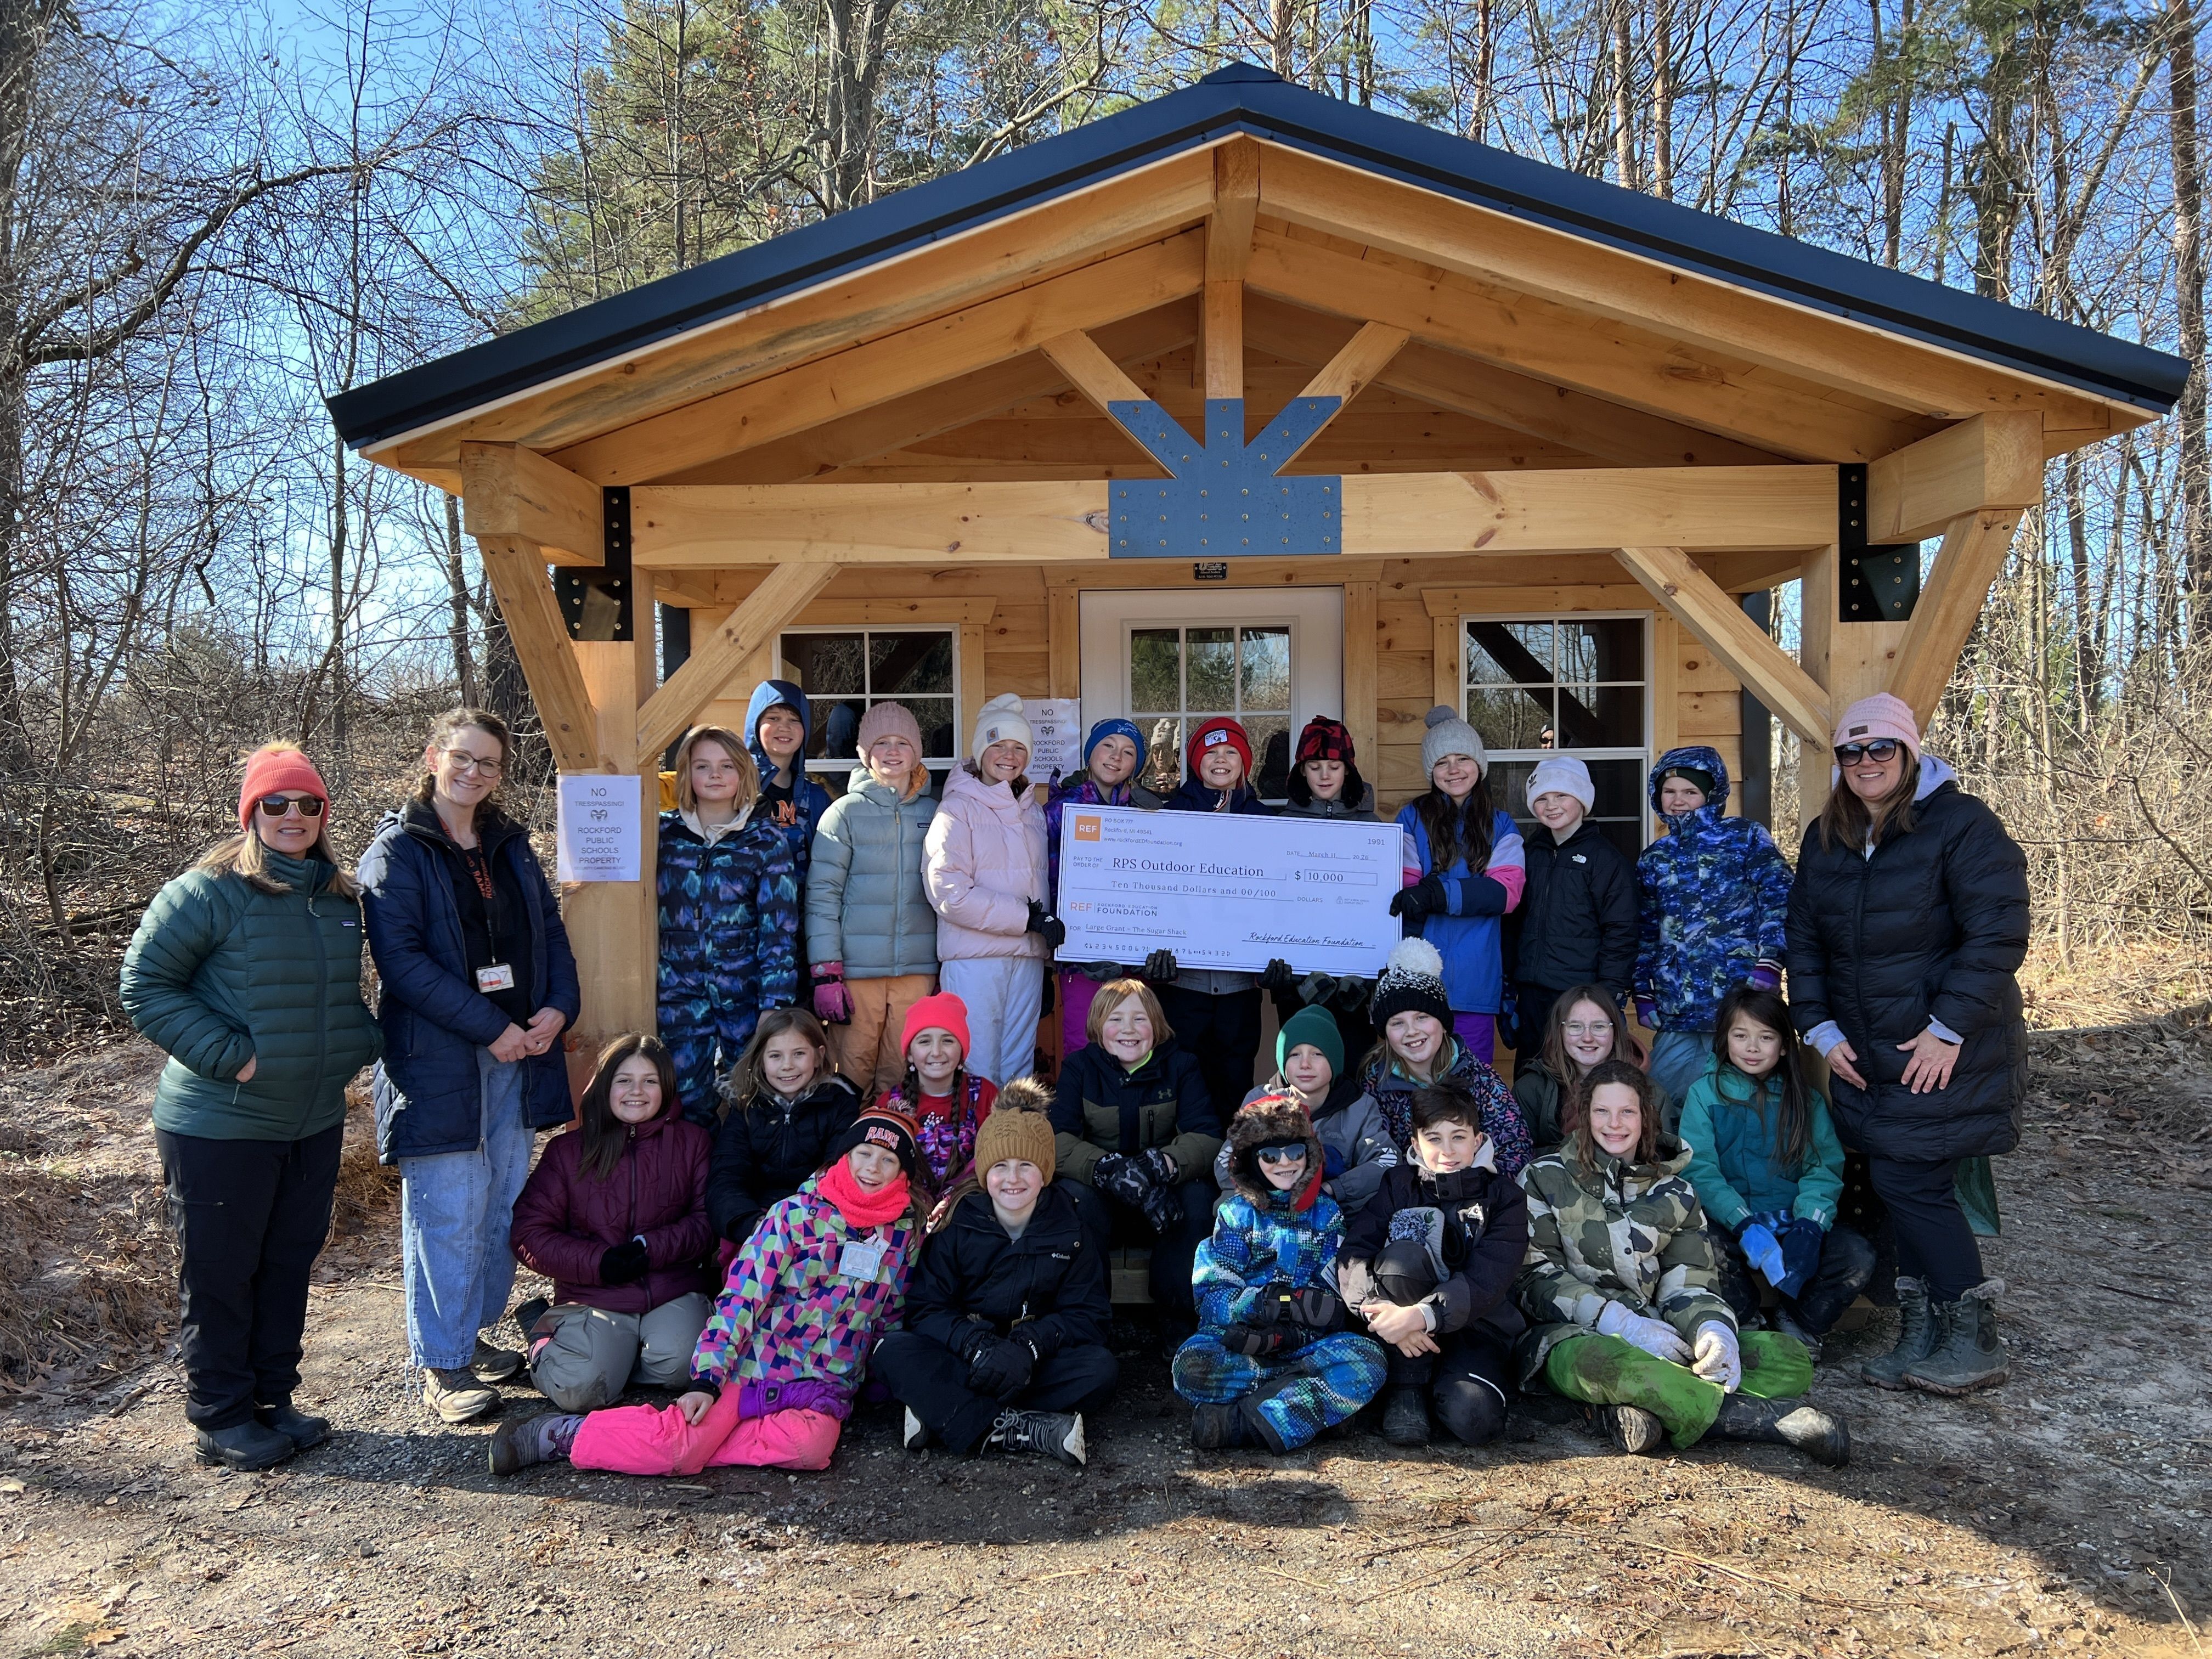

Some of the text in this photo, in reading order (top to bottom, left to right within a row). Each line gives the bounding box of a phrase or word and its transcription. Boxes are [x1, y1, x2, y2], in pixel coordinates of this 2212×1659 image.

[591, 788, 607, 797] NO
[1079, 825, 1097, 833] REF
[1104, 837, 1183, 847] www.rockfordEDfoundation.org
[1113, 857, 1264, 877] RPS Outdoor Education
[1294, 870, 1344, 883] $ 10,000
[1111, 881, 1276, 898] Ten Thousand Dollars and 00/100
[1070, 902, 1092, 911] REF
[1097, 907, 1158, 917] FOUNDATION
[1249, 932, 1363, 946] Rockford Education Foundation
[865, 1126, 900, 1150] RAMS
